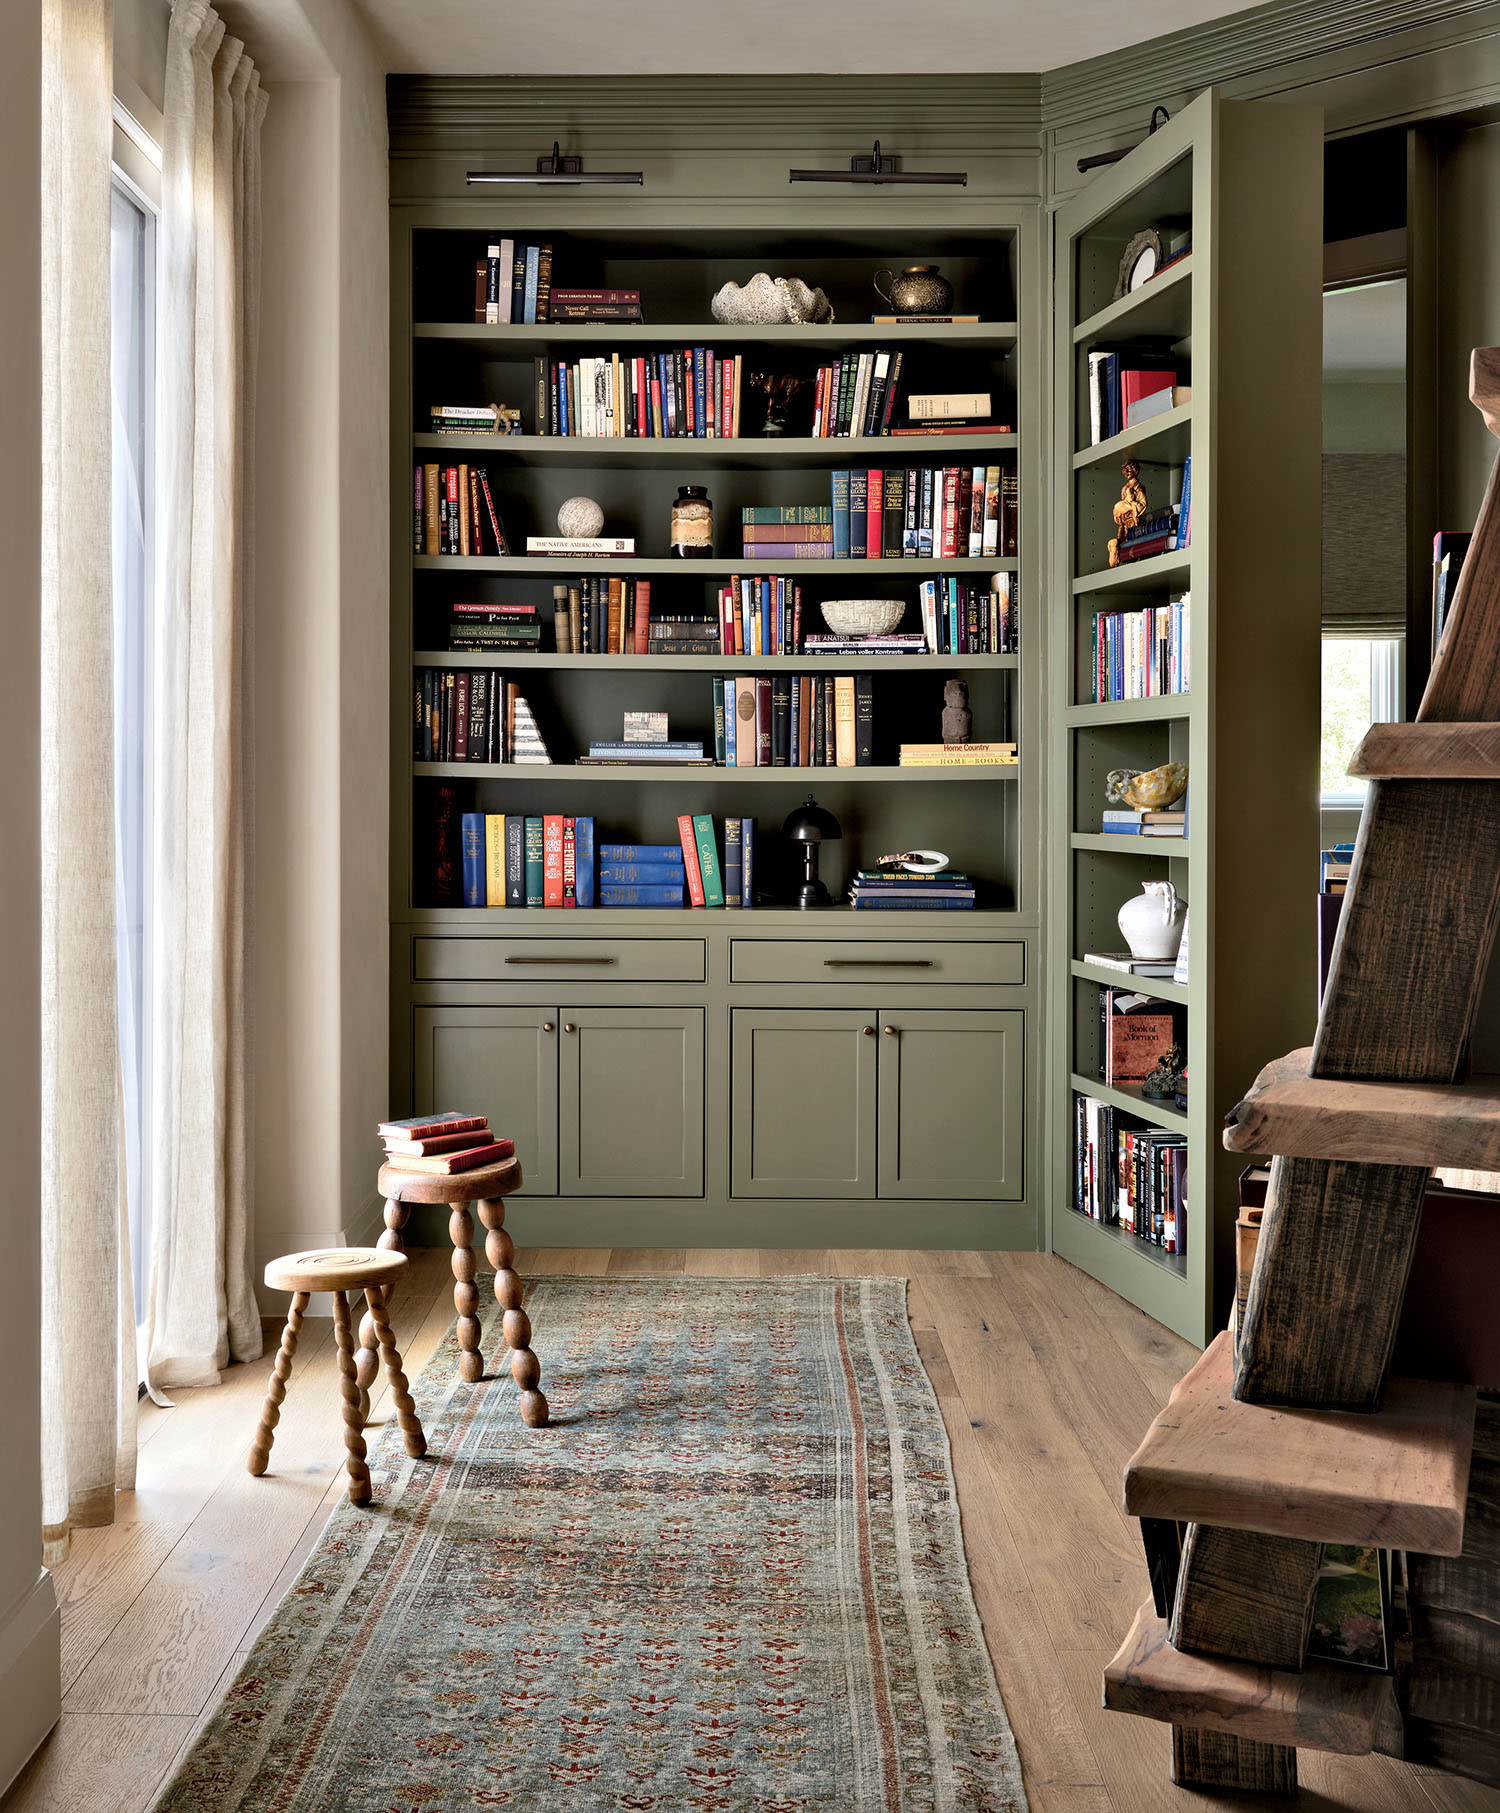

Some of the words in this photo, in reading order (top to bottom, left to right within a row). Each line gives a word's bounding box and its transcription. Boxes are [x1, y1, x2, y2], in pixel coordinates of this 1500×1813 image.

[429, 470, 437, 486] Alan
[448, 470, 457, 498] Arrogance
[924, 470, 932, 484] SPIRIT
[947, 487, 955, 501] THIRD
[427, 488, 436, 528] Greenspan
[482, 480, 491, 500] DEATH
[492, 516, 502, 545] STRANGER
[946, 503, 955, 528] THOUSAND
[946, 530, 954, 545] YEARS
[488, 614, 496, 622] P
[692, 644, 707, 652] Cristo
[944, 744, 962, 752] Home
[682, 820, 691, 834] LOST
[564, 849, 574, 882] EVIDENCE
[701, 844, 714, 877] CATHER
[1129, 1025, 1148, 1033] Book
[1149, 1025, 1157, 1033] of
[1124, 1033, 1159, 1041] Mormon
